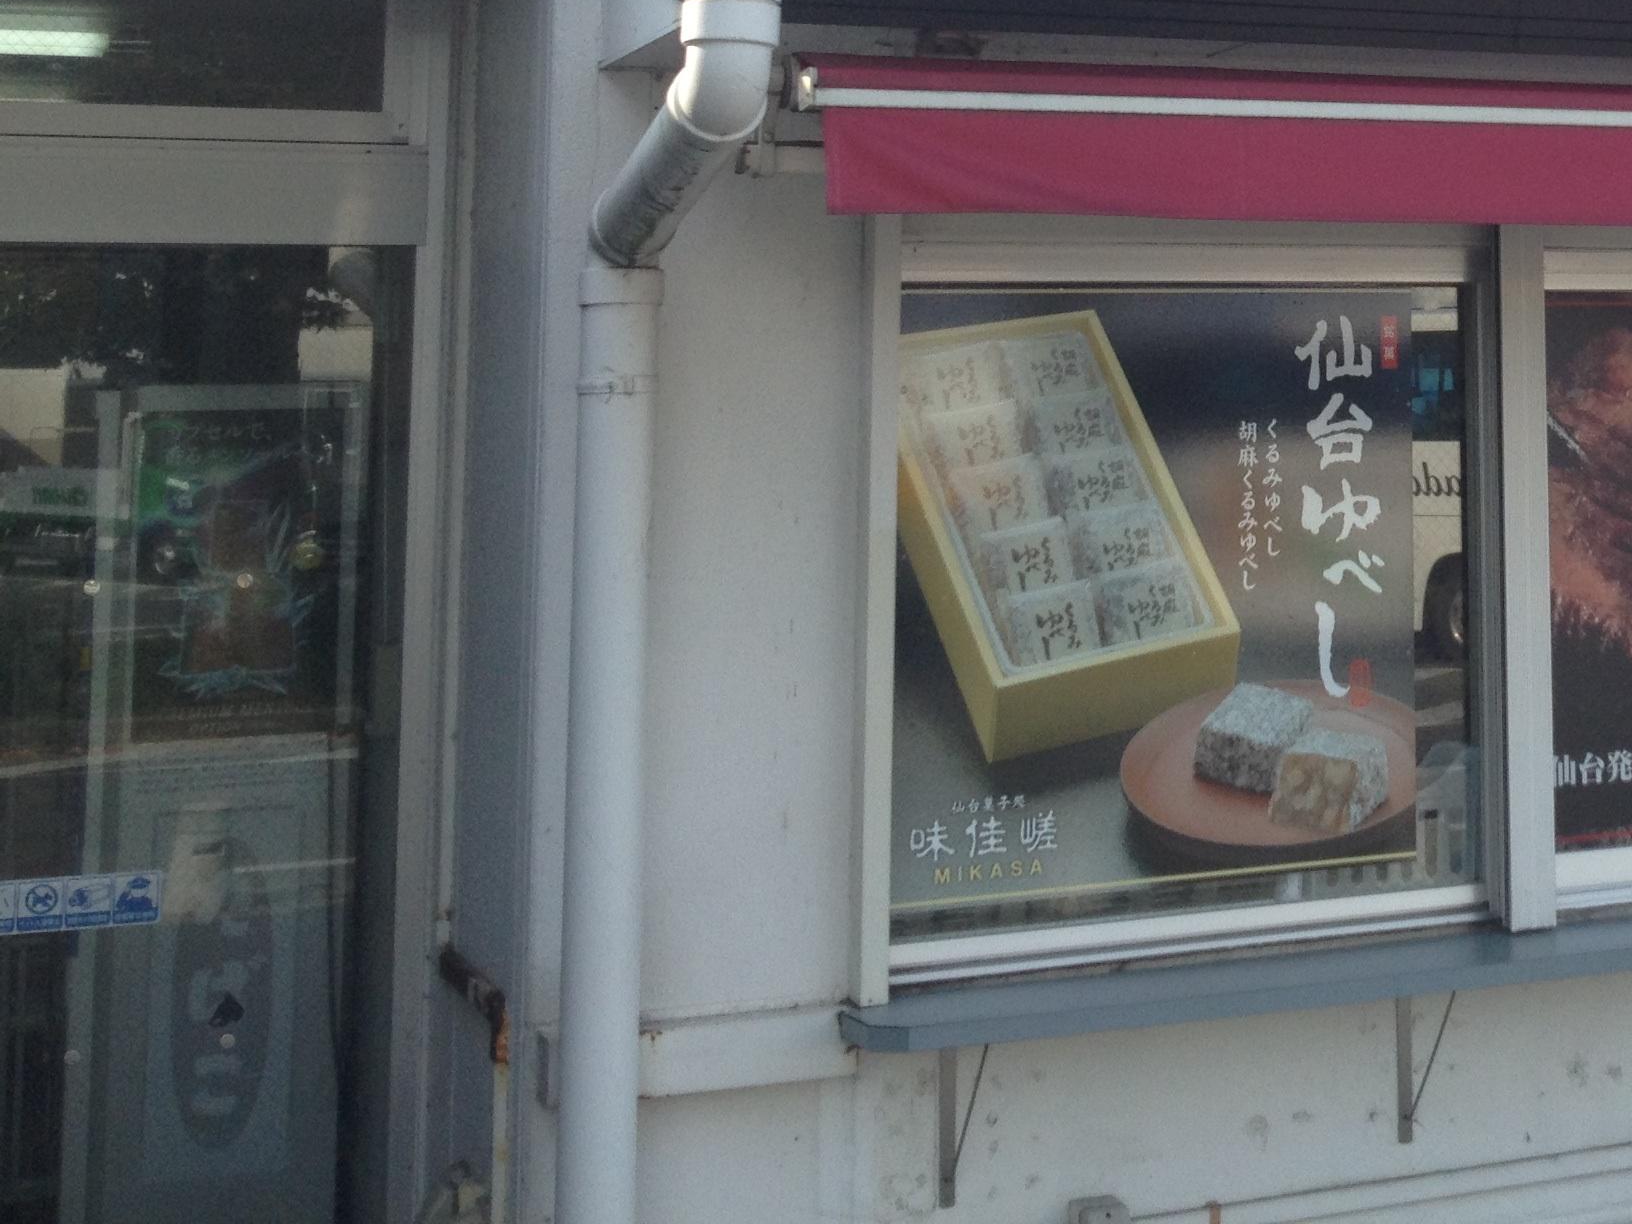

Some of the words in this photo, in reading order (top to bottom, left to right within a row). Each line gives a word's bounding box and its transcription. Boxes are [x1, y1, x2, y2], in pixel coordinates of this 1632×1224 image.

[1237, 420, 1259, 591] 胡麻くるみゆべし
[1262, 417, 1283, 557] くるみゆべし
[1294, 316, 1385, 698] 仙台ゆべし
[933, 858, 1044, 886] MIKASA
